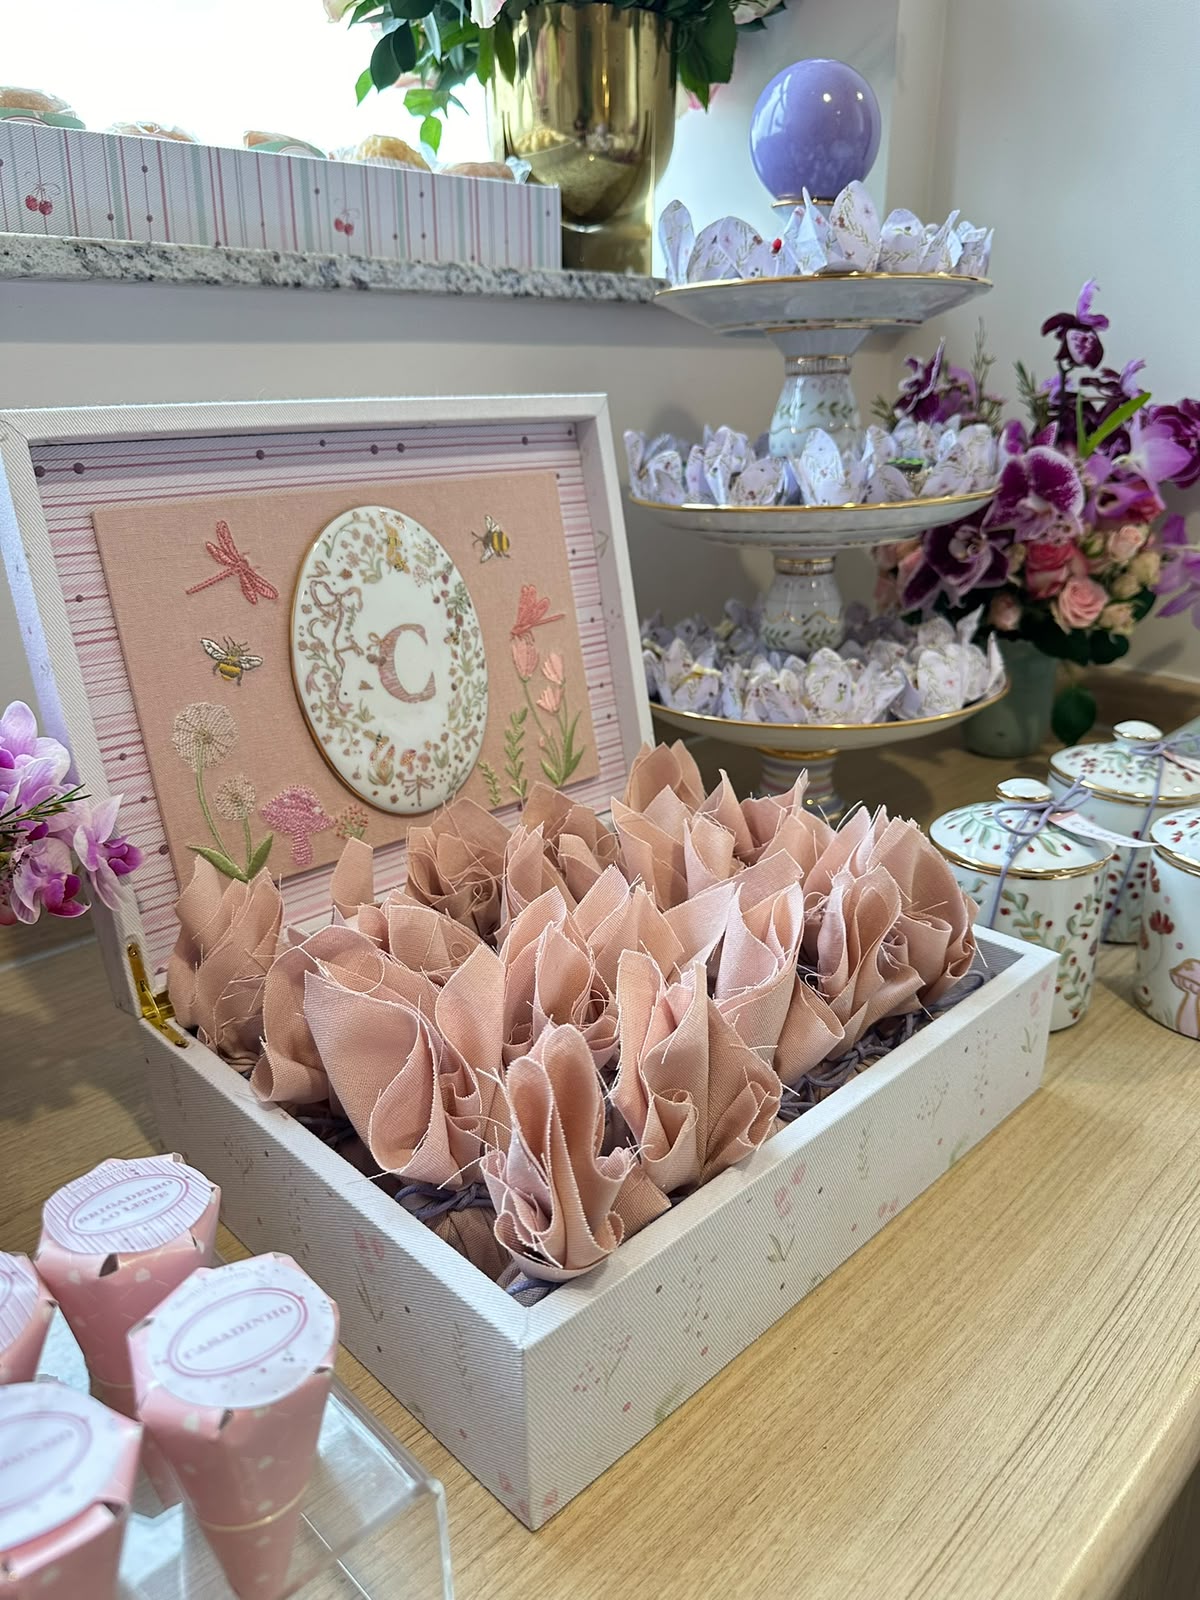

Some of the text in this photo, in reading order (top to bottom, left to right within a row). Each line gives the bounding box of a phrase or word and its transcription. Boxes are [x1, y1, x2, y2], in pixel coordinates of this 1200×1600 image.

[378, 623, 437, 703] C
[77, 1179, 174, 1225] BRIGADEIRO
[100, 1191, 170, 1225] AO LEITE
[183, 1304, 294, 1361] CASADINHO
